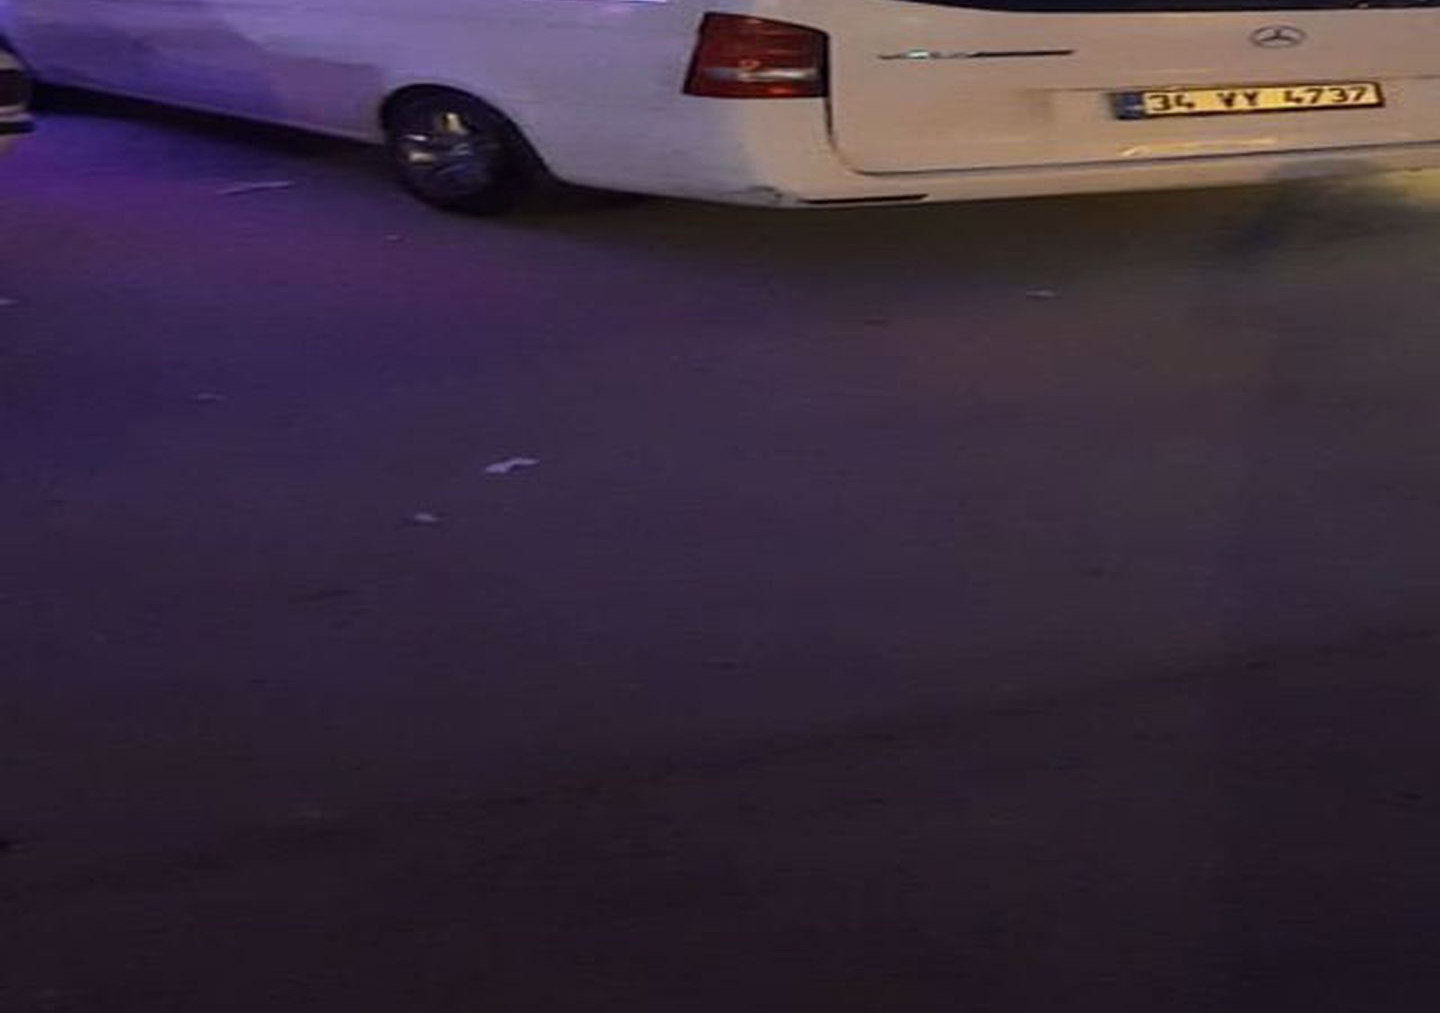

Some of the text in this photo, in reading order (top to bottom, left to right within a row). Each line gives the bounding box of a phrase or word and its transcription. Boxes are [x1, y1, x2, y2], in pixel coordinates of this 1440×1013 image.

[1147, 86, 1368, 111] 34 VY 4737
